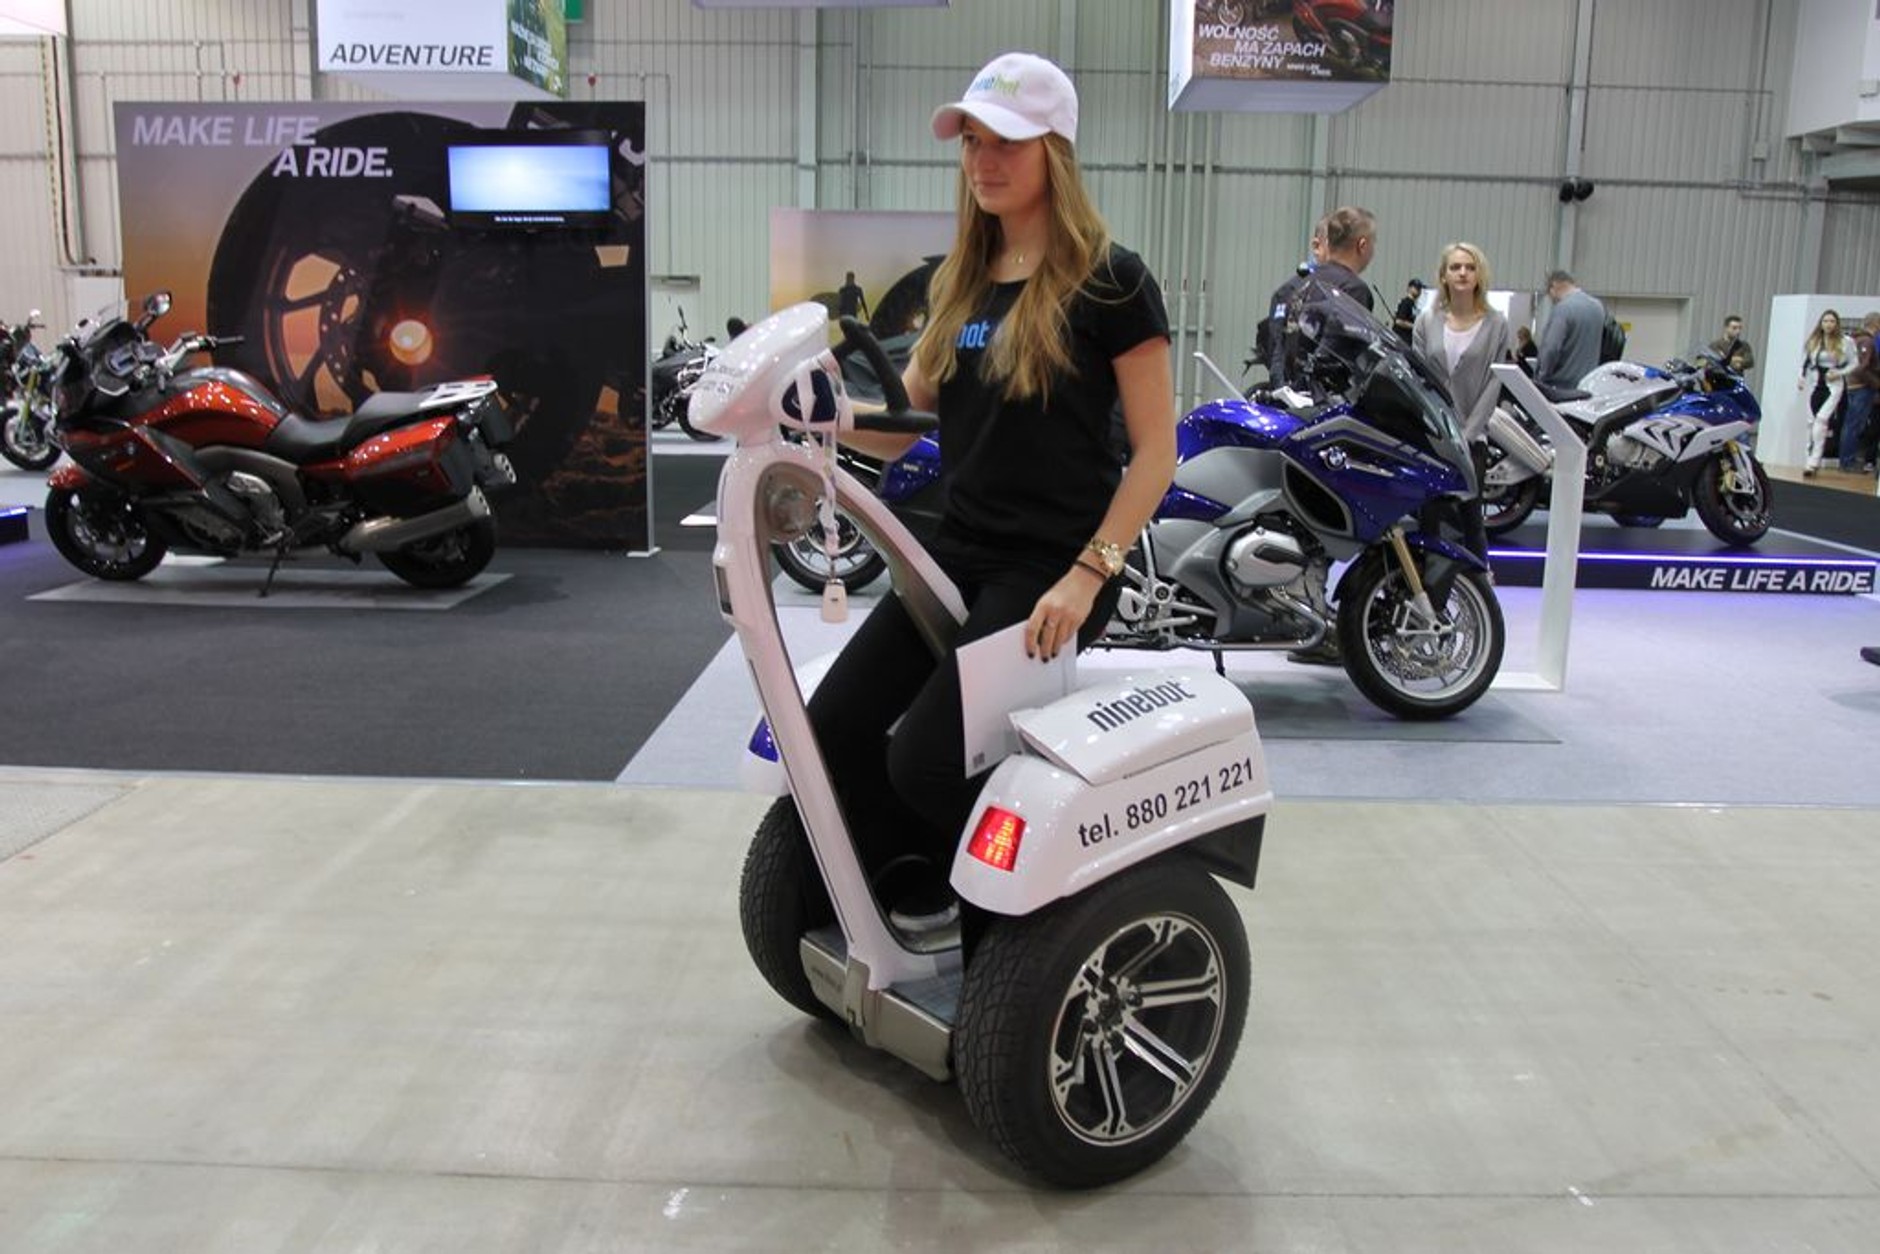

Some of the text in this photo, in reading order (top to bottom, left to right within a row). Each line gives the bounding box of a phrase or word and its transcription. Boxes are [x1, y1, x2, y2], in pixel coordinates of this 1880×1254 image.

[1199, 24, 1279, 41] WOLNOŚĆ
[329, 43, 494, 67] ADVENTURE
[1210, 54, 1284, 68] BENZYNY
[1234, 41, 1325, 57] MA ZAPACH
[132, 115, 320, 146] MAKE LIFE
[272, 147, 393, 177] A RIDE.
[1652, 567, 1872, 592] MAKE LIFE A RIDE.
[1087, 680, 1196, 731] ninebot
[1078, 757, 1252, 847] tel. 880 221 221
